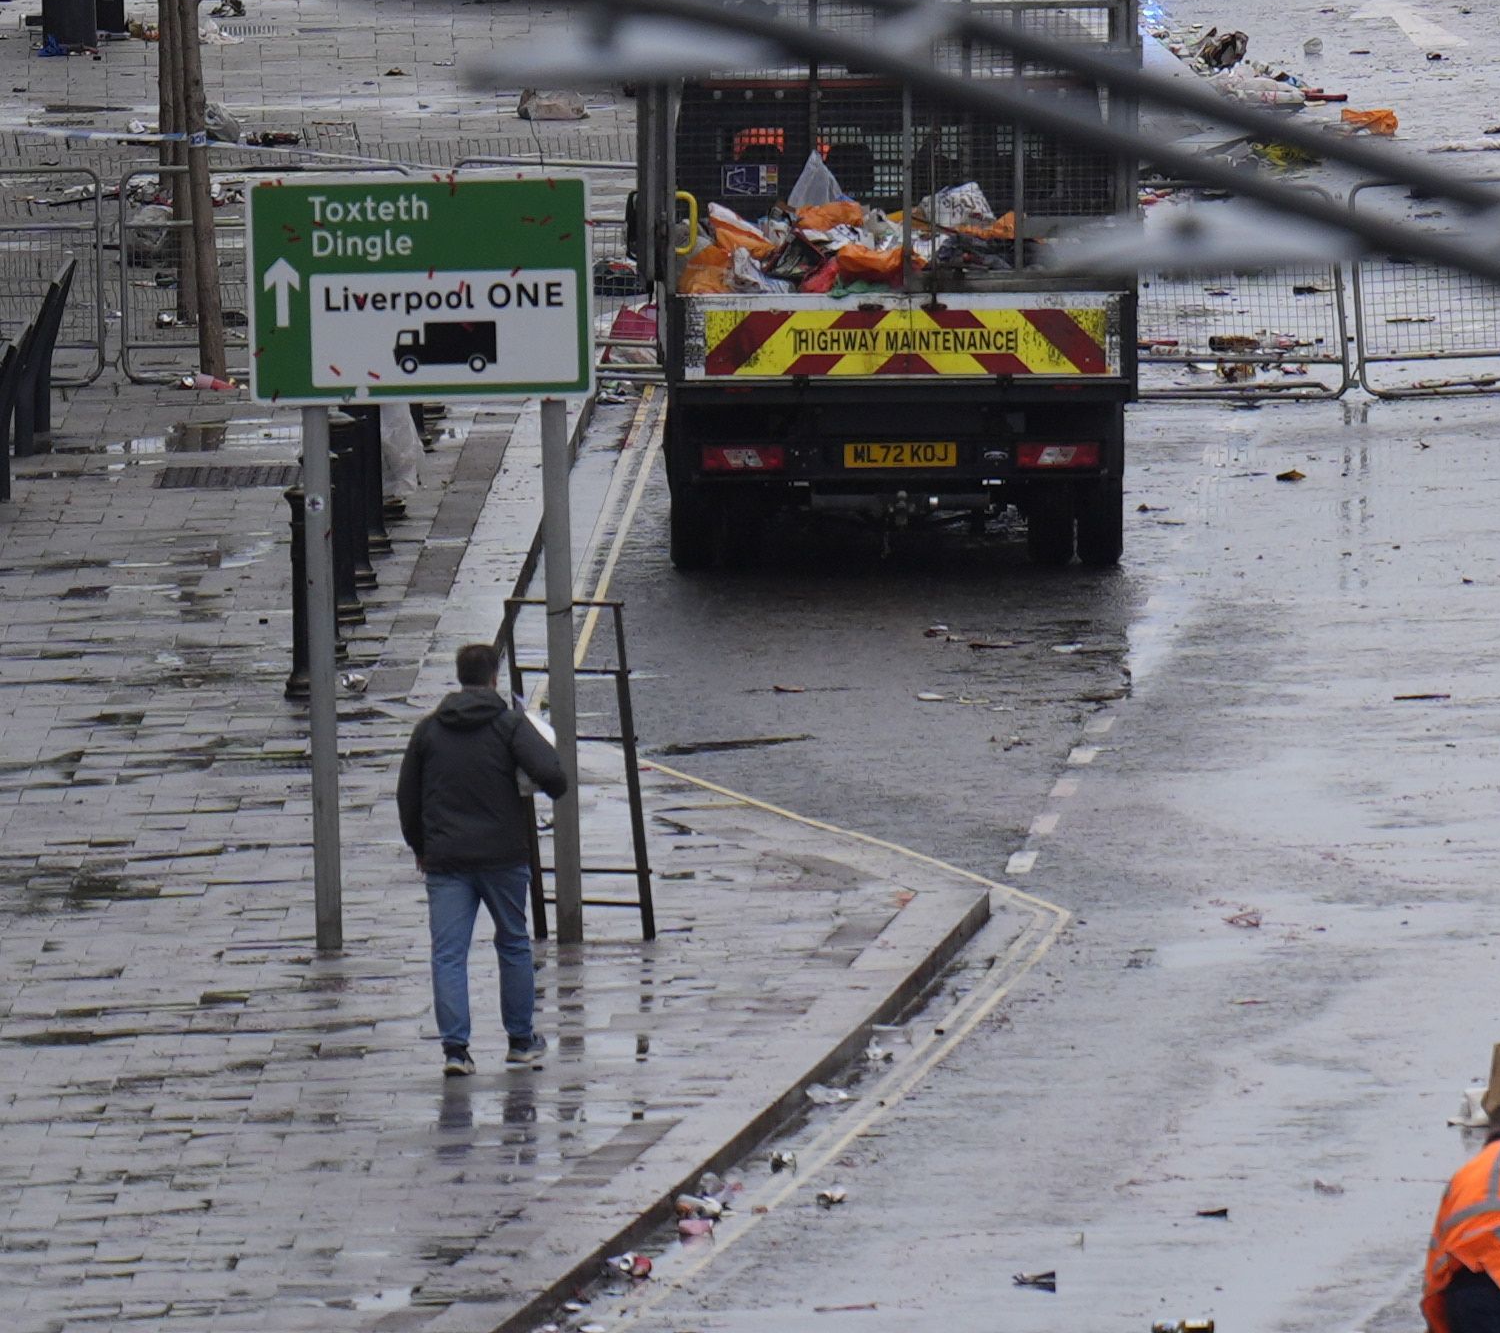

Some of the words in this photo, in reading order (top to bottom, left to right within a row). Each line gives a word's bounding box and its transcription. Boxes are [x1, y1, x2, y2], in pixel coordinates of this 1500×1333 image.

[308, 196, 429, 224] Toxteth
[312, 230, 413, 262] Dingle
[325, 281, 474, 314] Liverpool
[488, 281, 564, 308] ONE
[800, 329, 879, 353] HIGHWAY
[885, 329, 1016, 352] MAINTENANCE
[853, 445, 905, 463] ML72
[910, 444, 949, 462] KOJ
